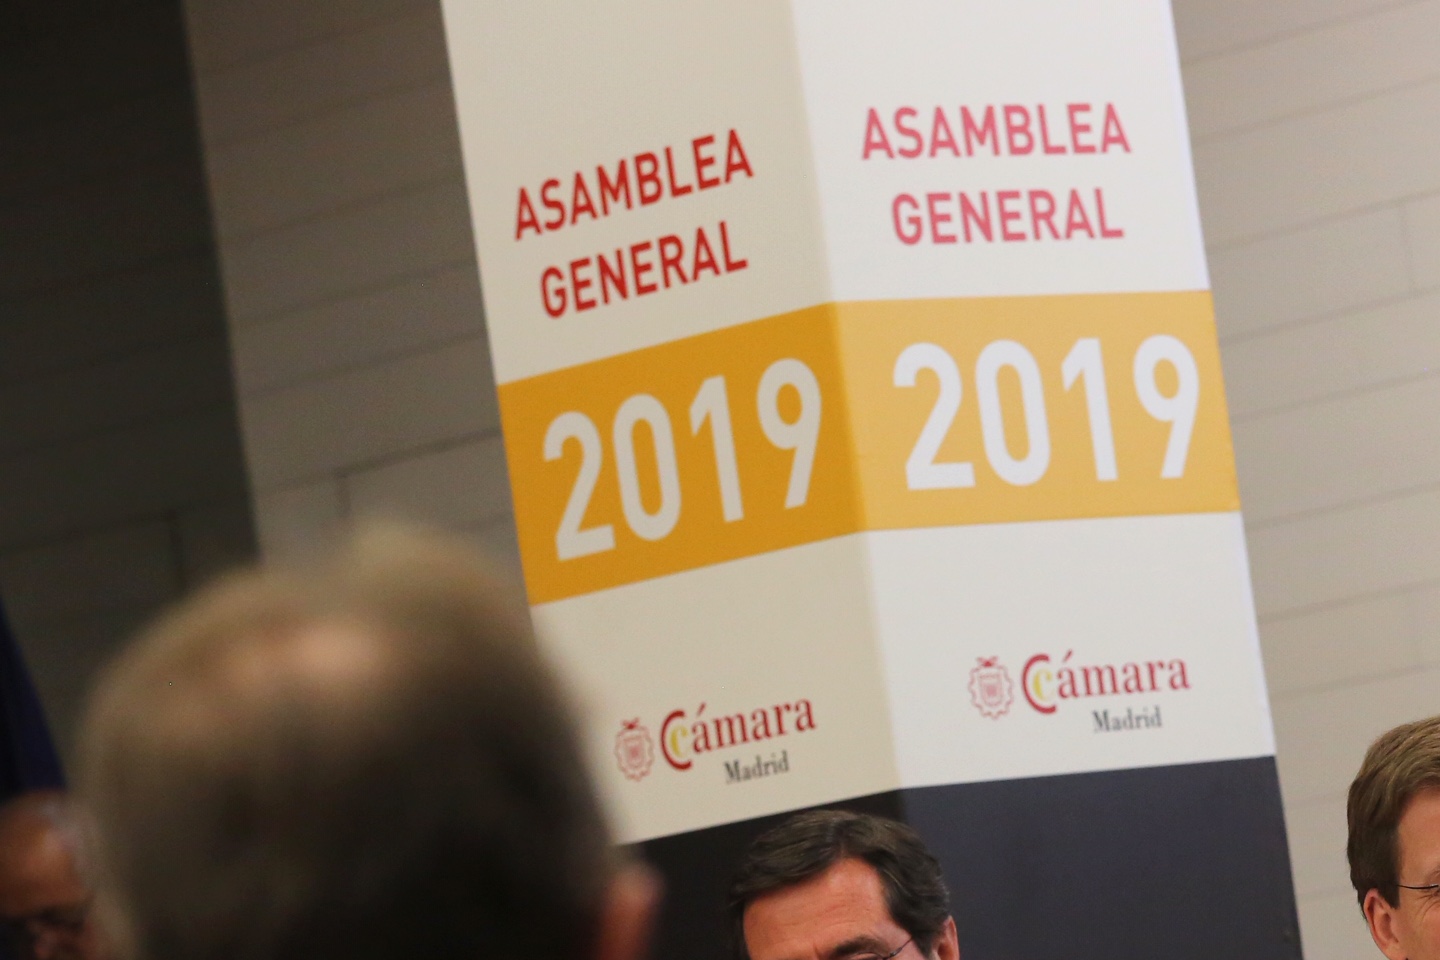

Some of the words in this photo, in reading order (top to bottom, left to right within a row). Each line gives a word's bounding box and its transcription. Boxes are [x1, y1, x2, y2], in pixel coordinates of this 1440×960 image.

[863, 103, 1131, 160] ASAMBLEA
[514, 129, 754, 241] ASAMBLEA
[891, 188, 1125, 246] GENERAL
[540, 221, 749, 319] GENERAL
[893, 334, 1200, 491] 2019
[542, 357, 822, 562] 2019
[1092, 705, 1162, 733] Madrid
[724, 750, 789, 784] Madrid
